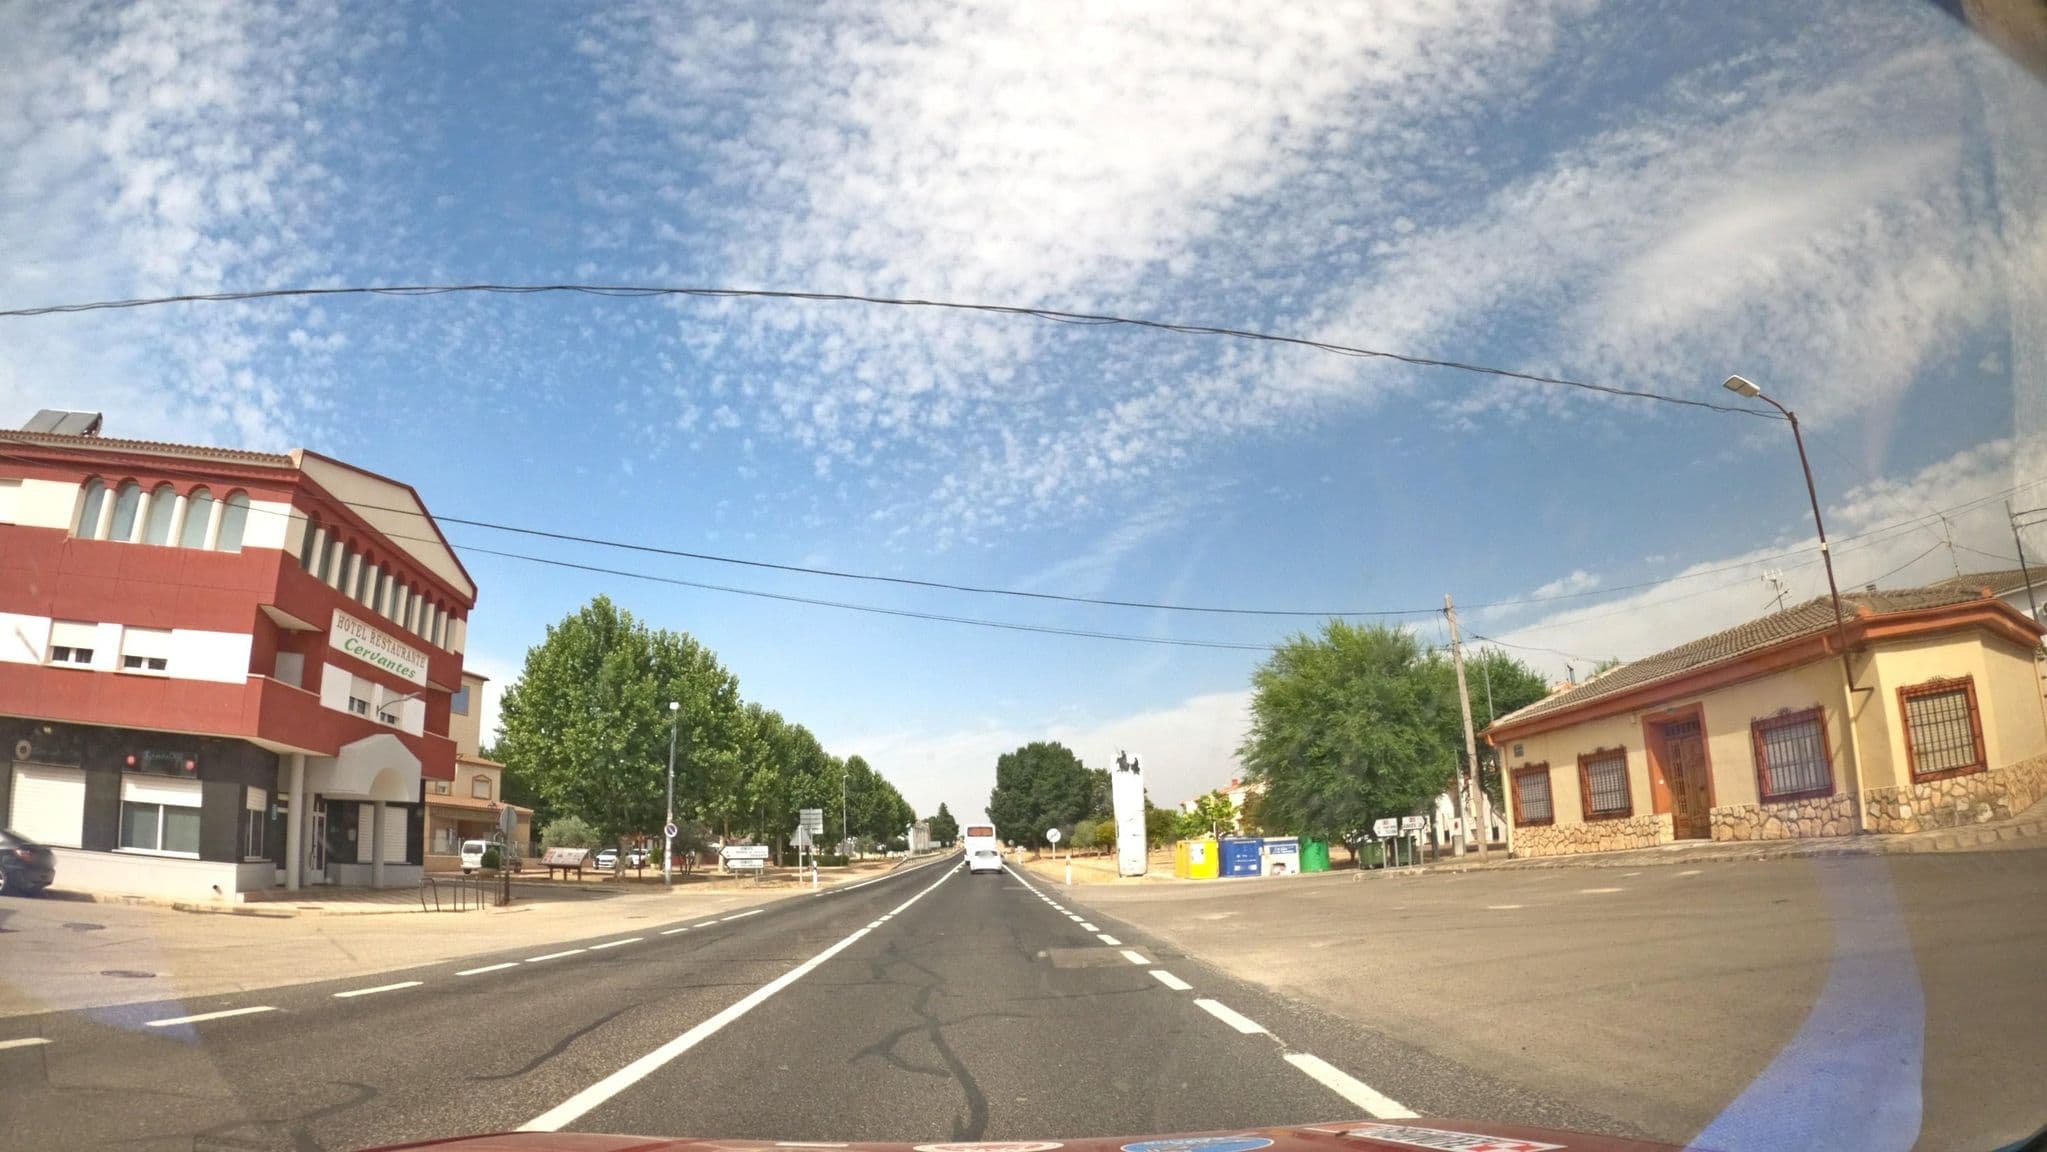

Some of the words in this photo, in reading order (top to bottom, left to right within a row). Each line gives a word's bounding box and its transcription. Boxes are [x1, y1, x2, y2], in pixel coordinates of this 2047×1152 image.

[336, 615, 366, 640] HOTEL
[369, 632, 426, 668] RESTAURANTE
[344, 638, 416, 678] Cervantes
